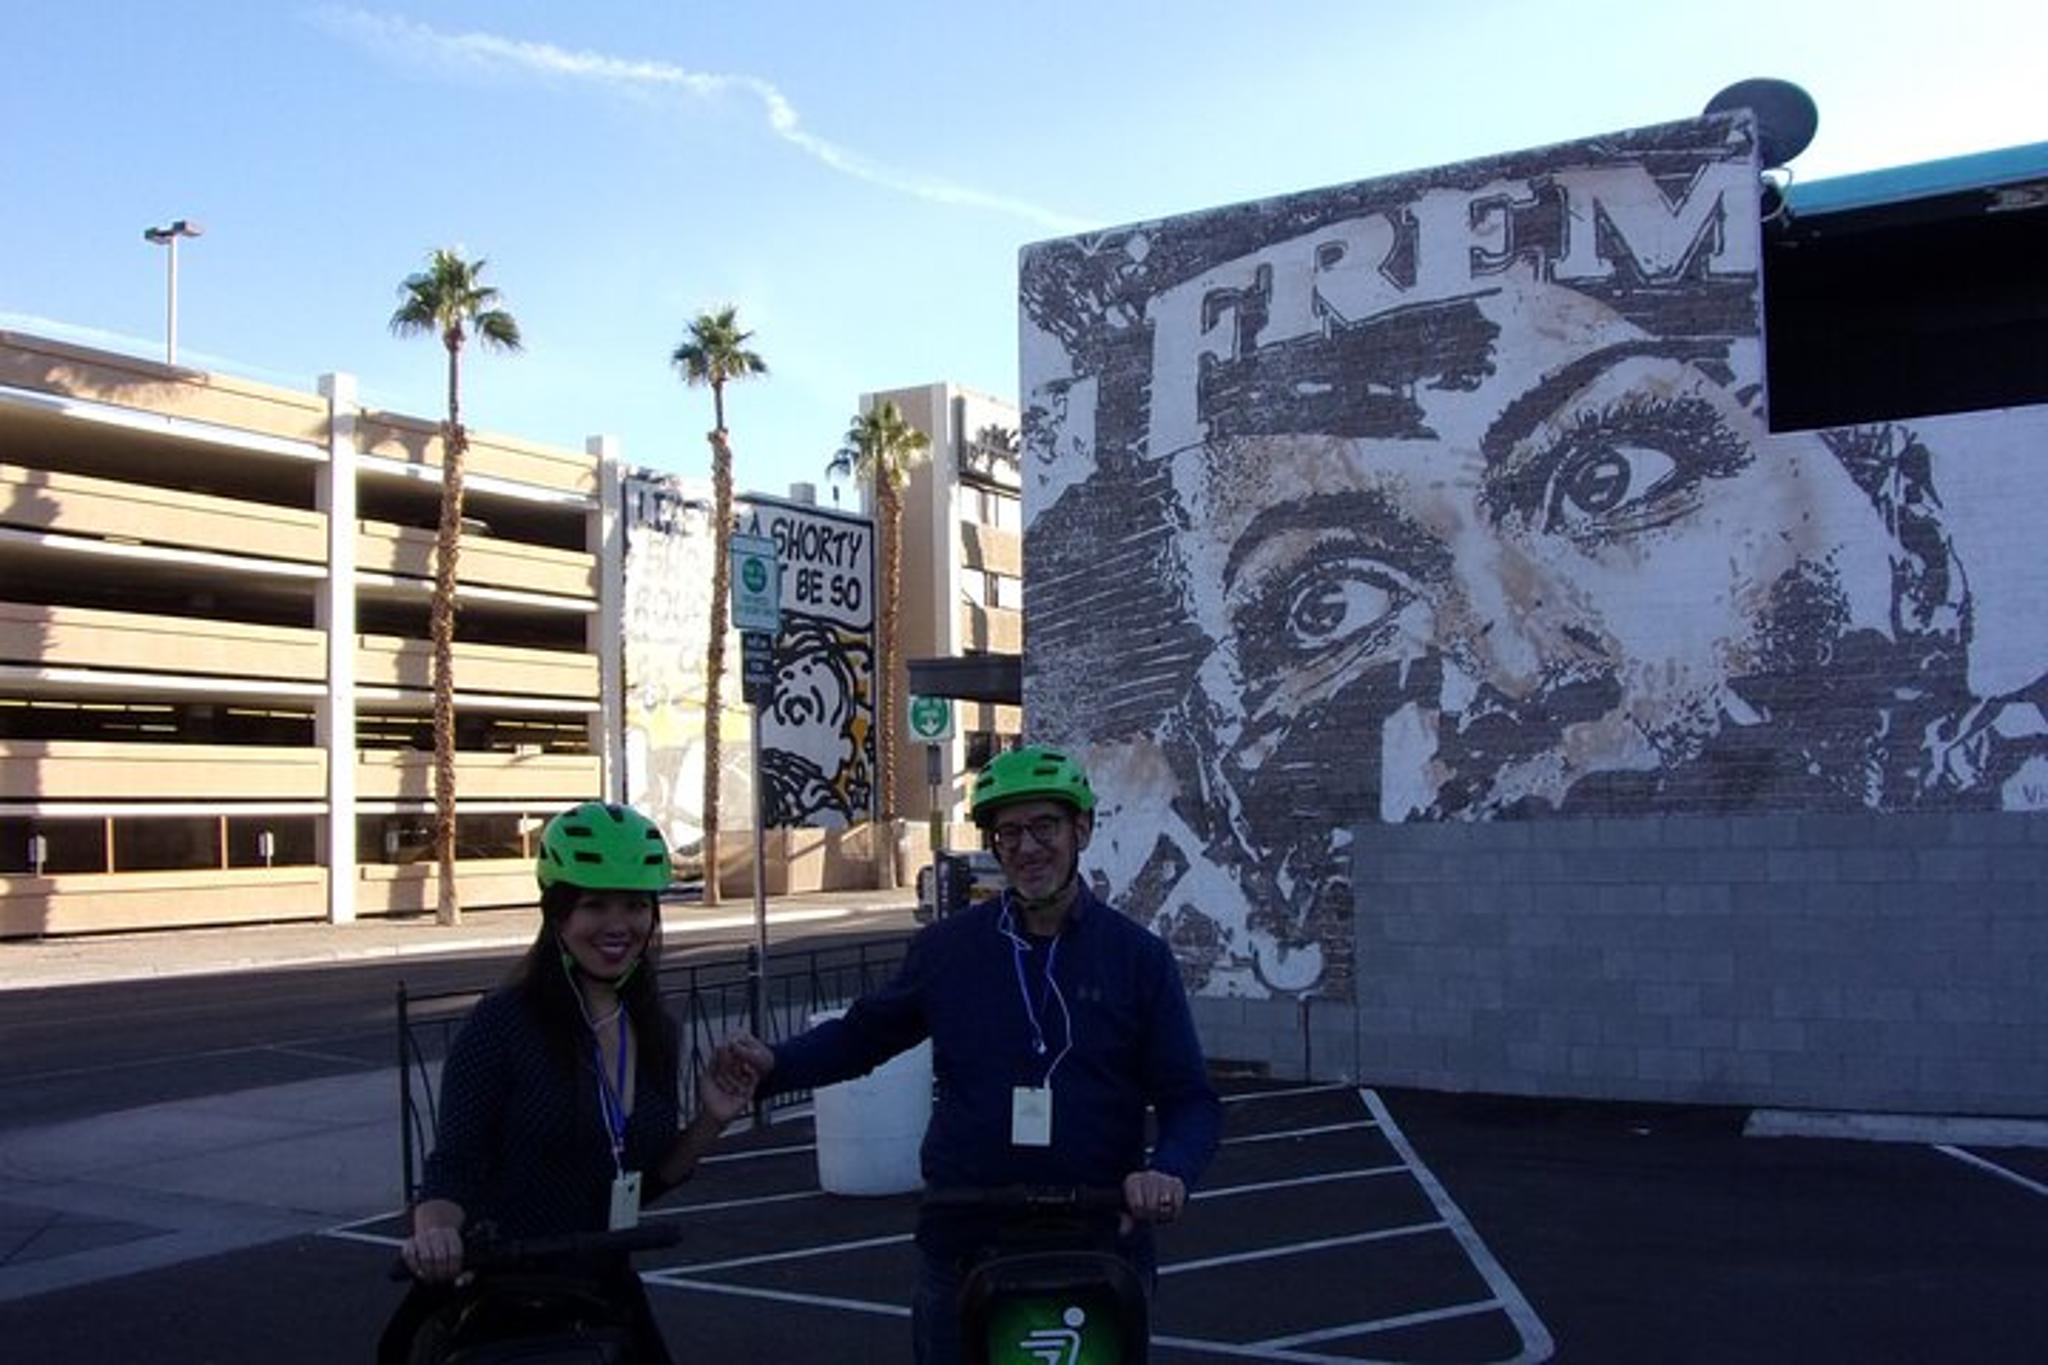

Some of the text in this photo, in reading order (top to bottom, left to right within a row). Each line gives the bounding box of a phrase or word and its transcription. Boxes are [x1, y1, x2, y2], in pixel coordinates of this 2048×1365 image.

[770, 516, 863, 570] SHORTY
[796, 567, 824, 605] BE
[829, 574, 862, 612] SO
